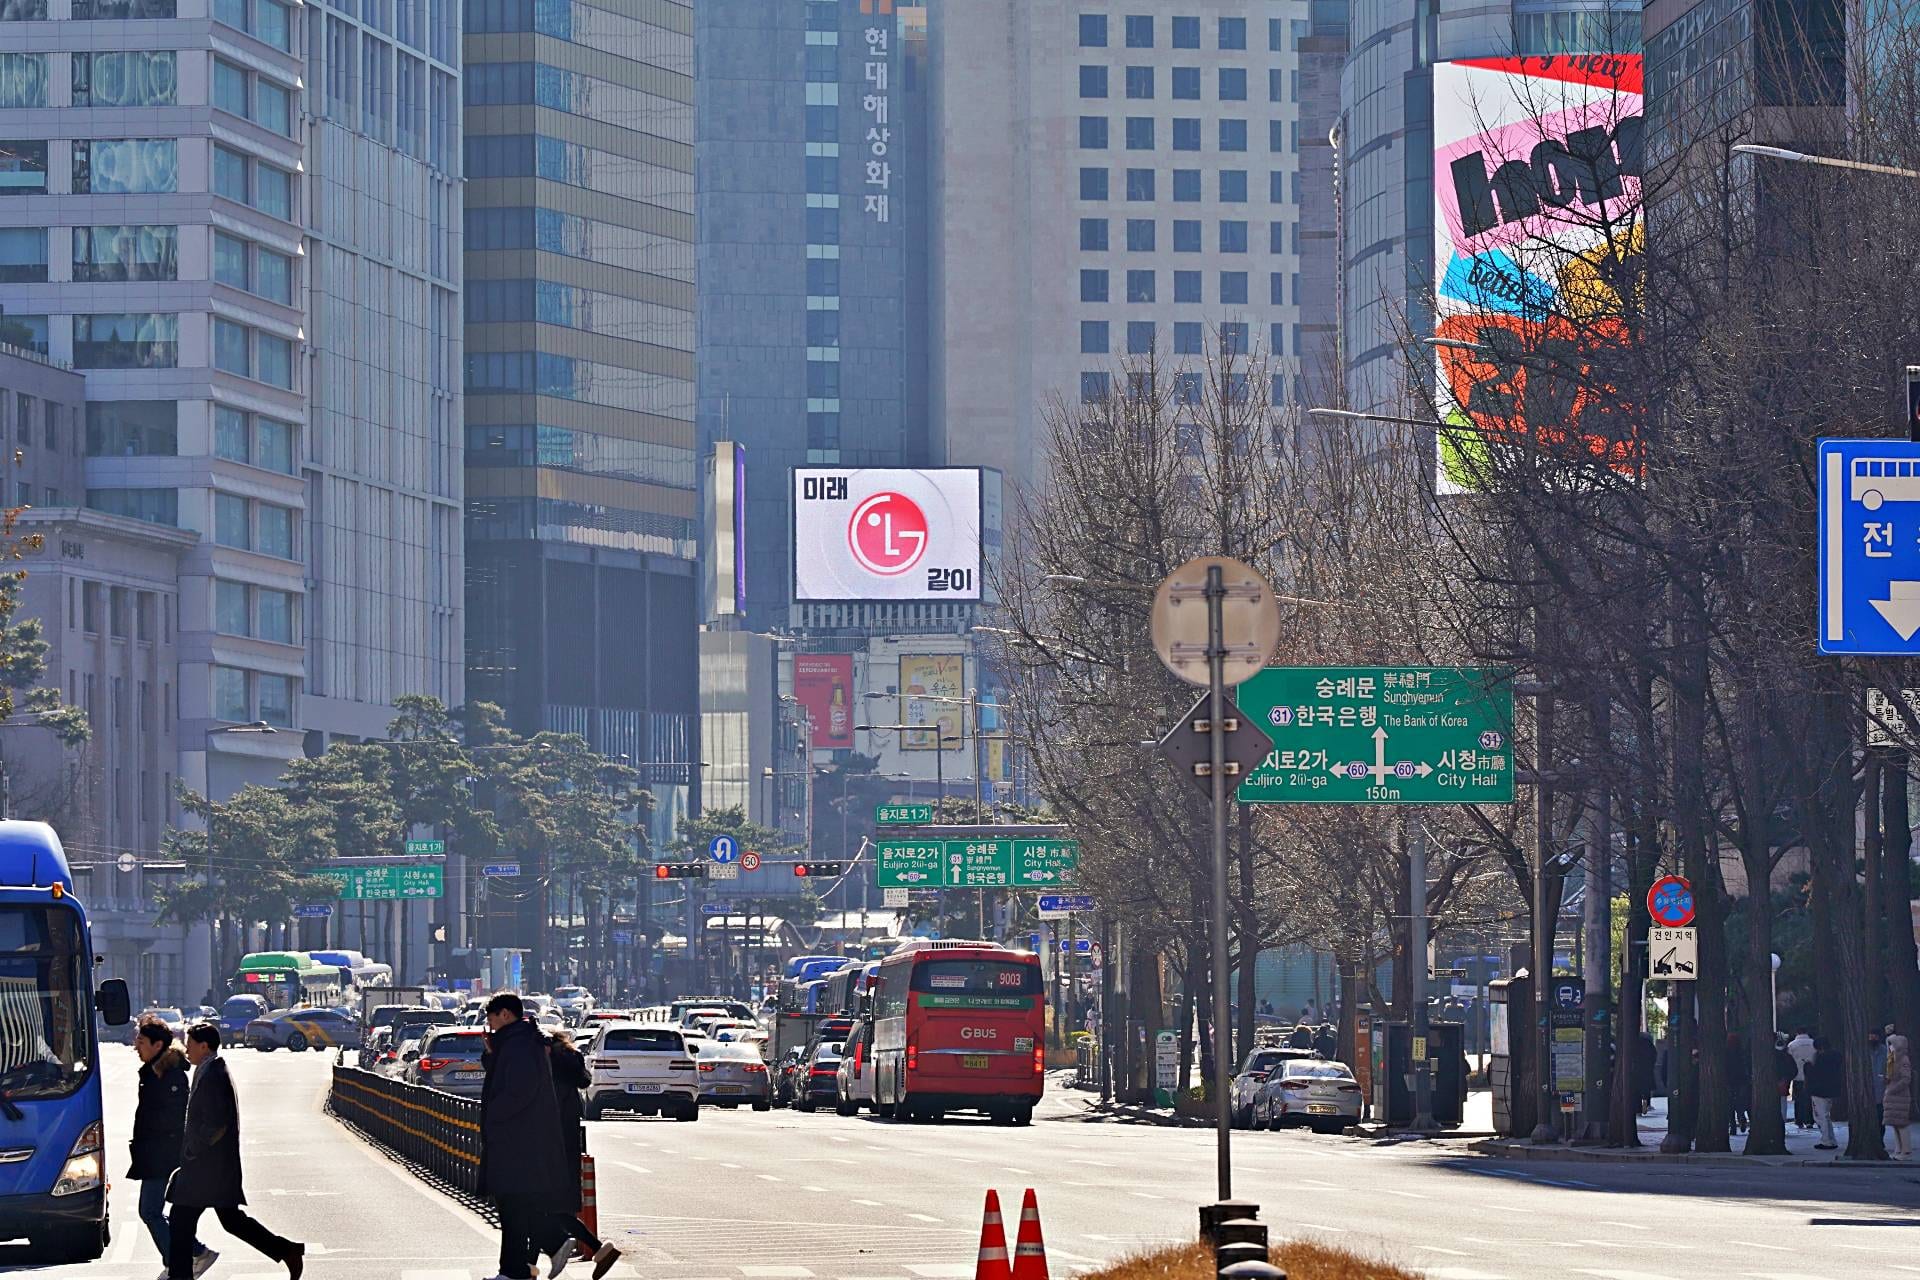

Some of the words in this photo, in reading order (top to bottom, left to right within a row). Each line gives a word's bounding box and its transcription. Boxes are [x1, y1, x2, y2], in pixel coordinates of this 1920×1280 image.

[863, 27, 891, 223] 현대해상화재
[803, 476, 848, 501] 미래
[850, 494, 926, 572] LG
[927, 567, 972, 591] 같이
[1315, 676, 1377, 698] 숭례문
[1273, 709, 1289, 723] 31
[1295, 705, 1377, 727] 한국은행
[1383, 715, 1402, 727] The
[1403, 715, 1428, 727] Bank
[1429, 714, 1439, 727] of
[1440, 715, 1468, 727] Korea
[1483, 733, 1498, 747] 31
[1254, 749, 1329, 771] 지로2가
[1437, 749, 1477, 771] 시청
[1350, 764, 1364, 776] 60
[1398, 764, 1412, 776] 60
[1289, 773, 1328, 789] 2(i)-ga
[1437, 773, 1466, 789] City
[1472, 773, 1497, 786] Hall
[1365, 788, 1400, 800] 150m
[879, 808, 929, 821] 을지로1가
[882, 847, 939, 859] 을지로2가
[966, 843, 999, 855] 숭례문
[1023, 846, 1047, 859] 시청
[883, 860, 909, 870] Euljiro
[1024, 859, 1042, 868] City
[908, 872, 919, 880] 60
[966, 872, 1006, 884] 한국은행
[999, 973, 1021, 986] 9003
